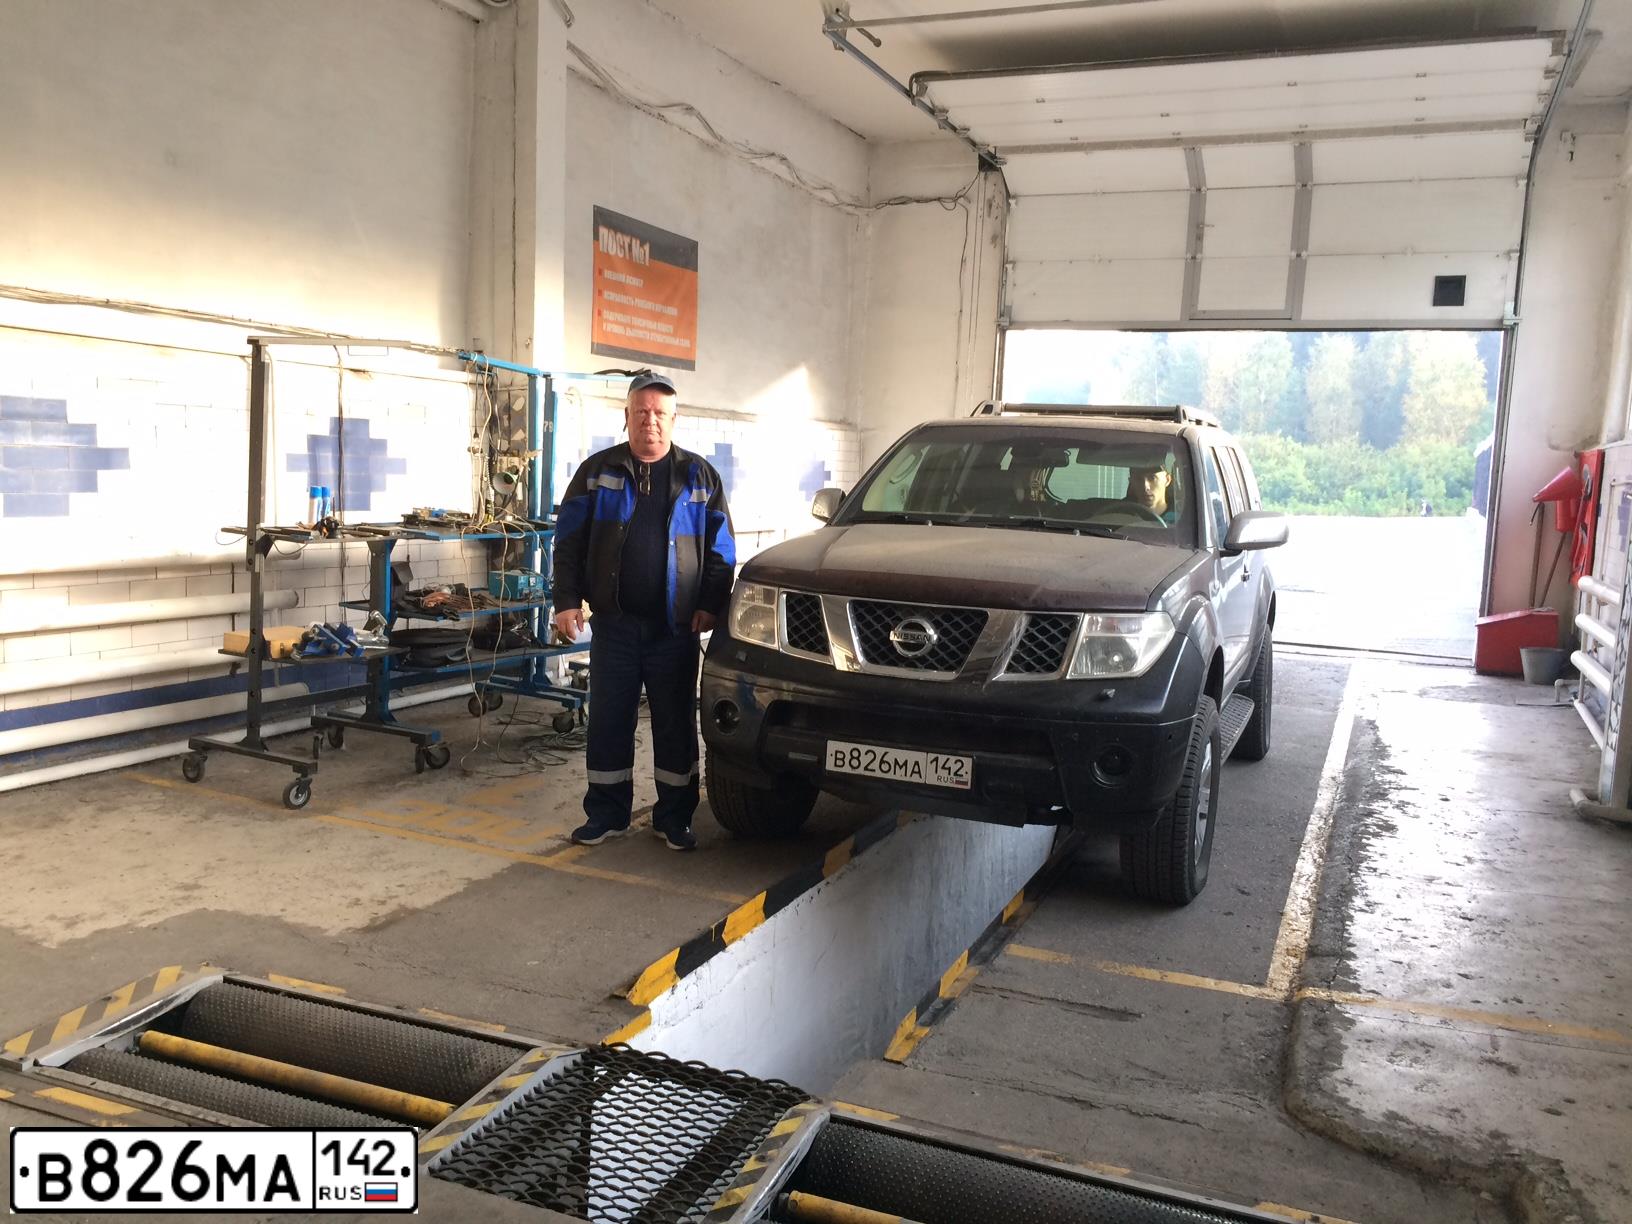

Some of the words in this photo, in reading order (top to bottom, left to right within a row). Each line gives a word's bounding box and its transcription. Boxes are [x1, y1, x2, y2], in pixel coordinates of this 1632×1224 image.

[598, 225, 631, 260] ПОСТ
[631, 236, 650, 266] №1
[893, 632, 930, 641] NISSAN
[834, 748, 922, 779] В826МА
[930, 756, 964, 777] 142
[936, 775, 955, 784] RUS
